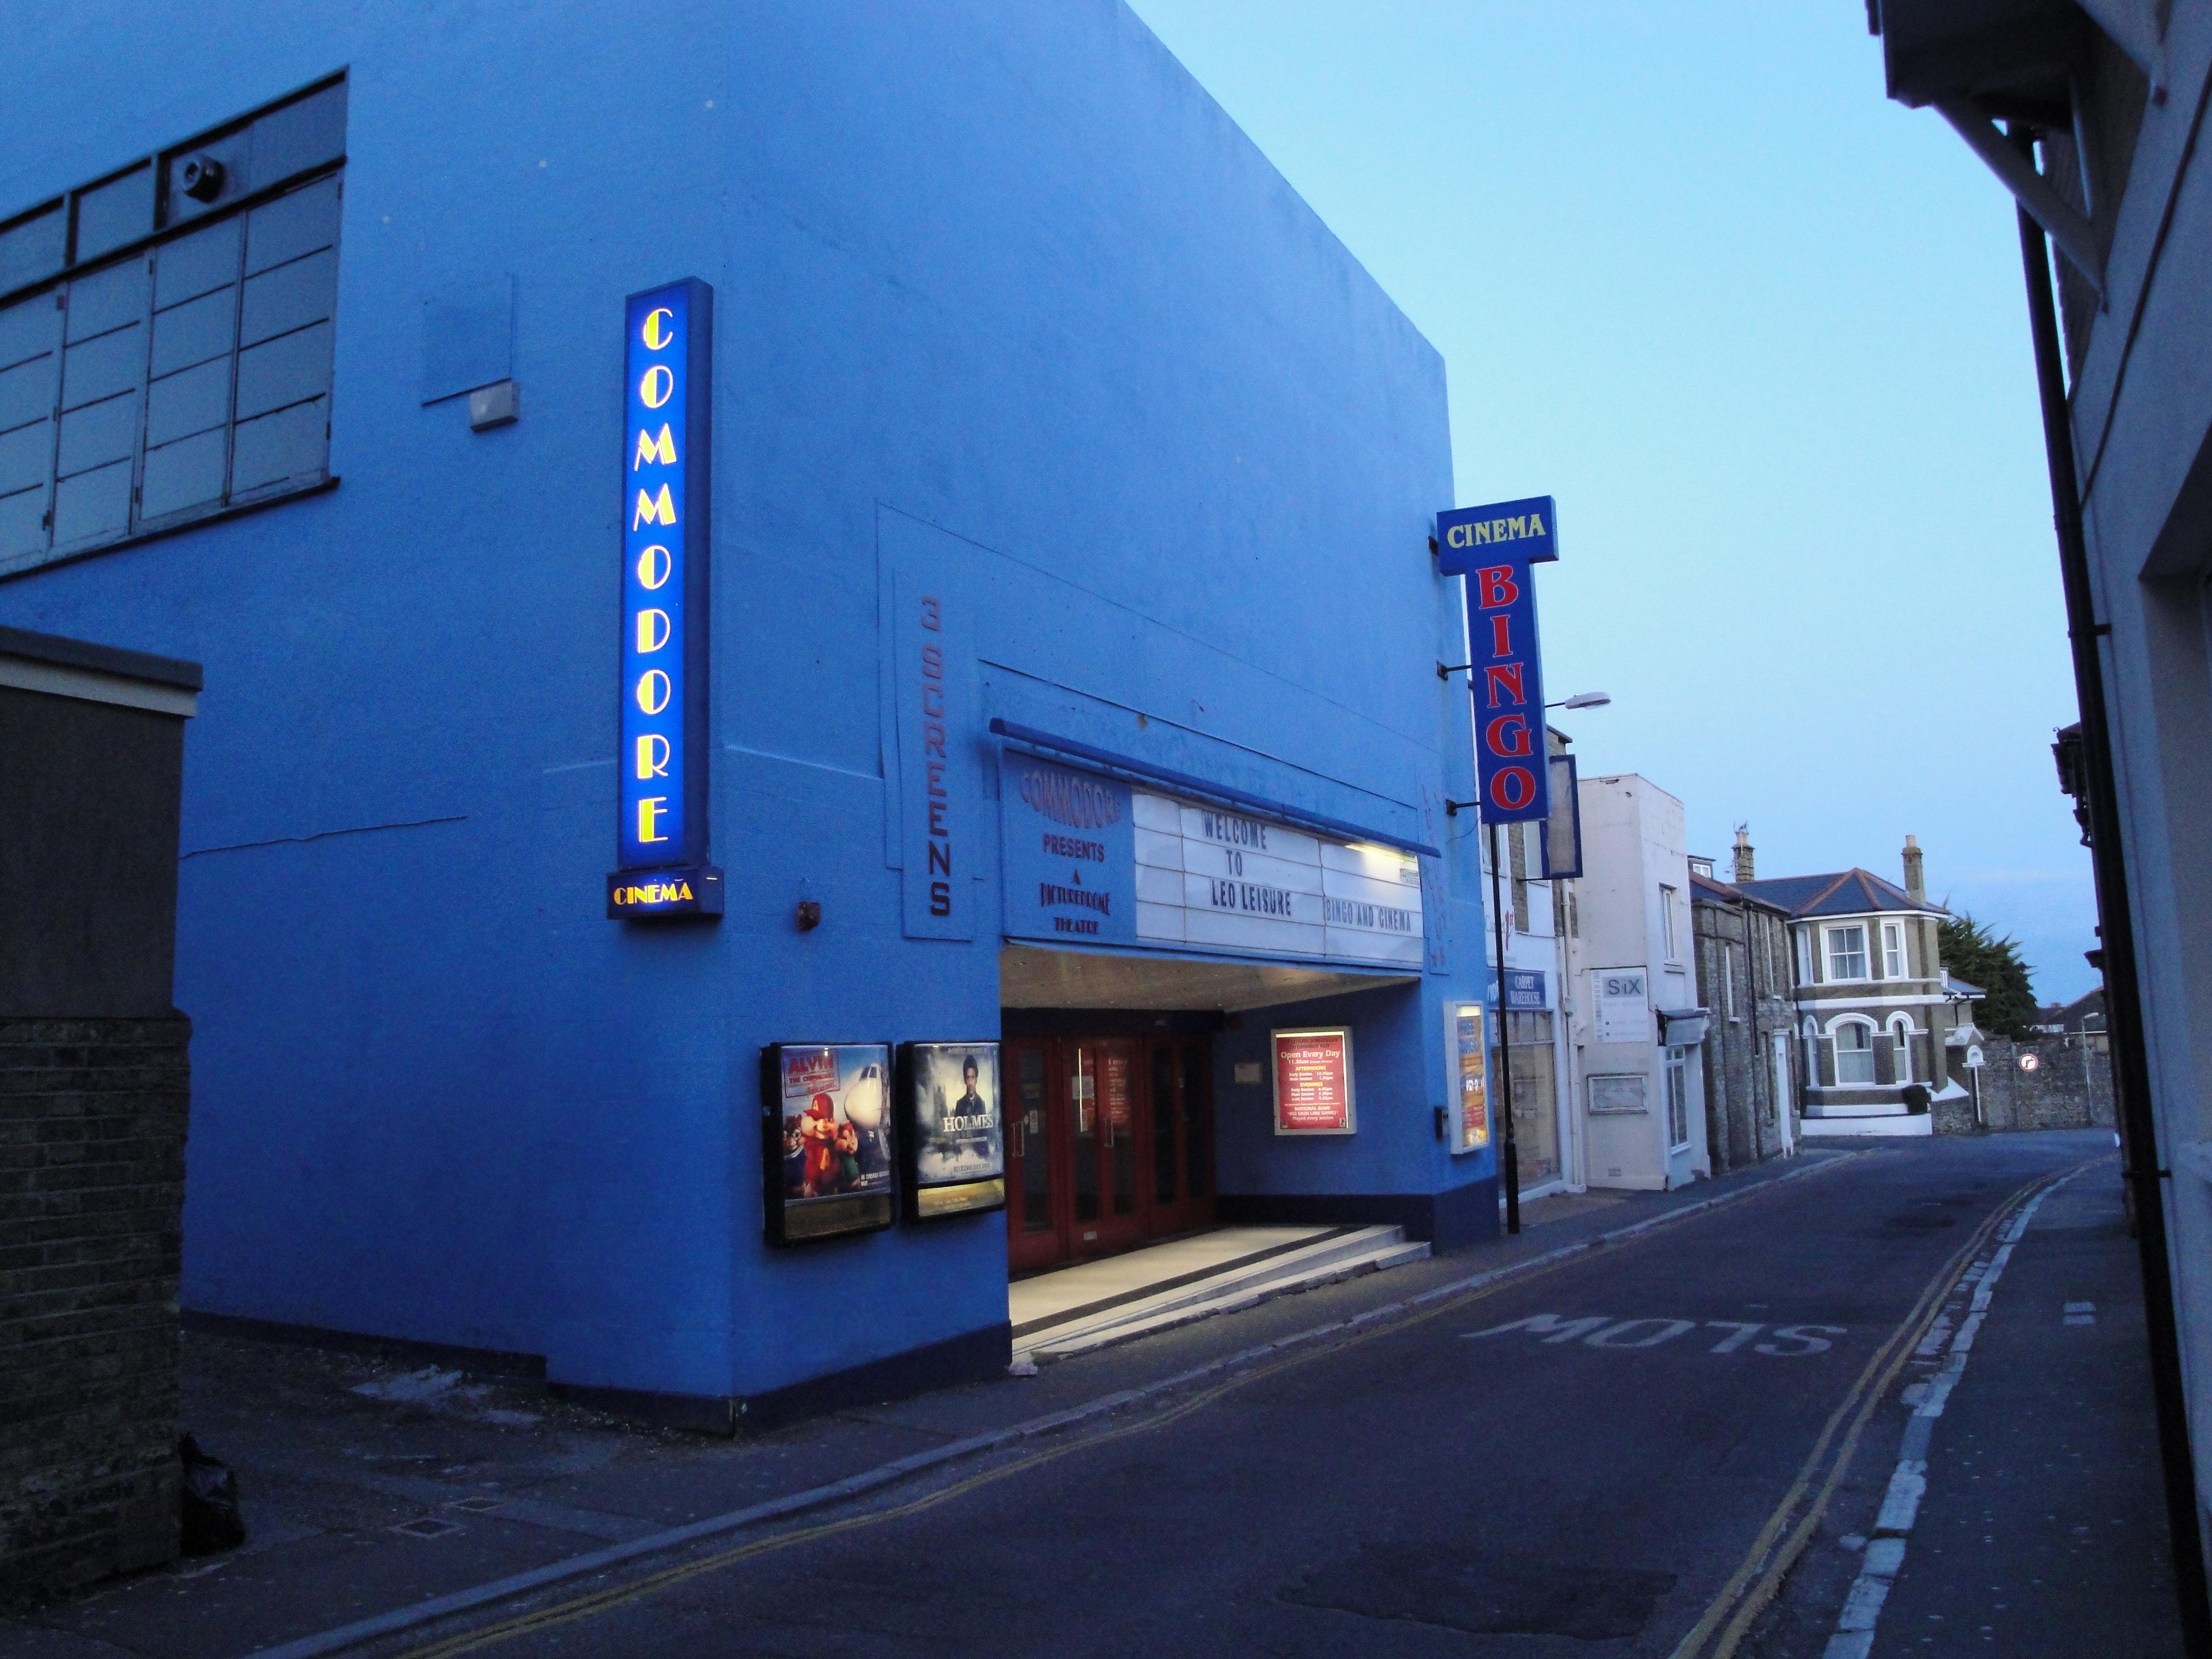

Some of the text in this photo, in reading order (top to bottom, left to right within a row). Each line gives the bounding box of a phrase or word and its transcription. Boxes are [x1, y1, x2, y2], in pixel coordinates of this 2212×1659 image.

[1446, 514, 1546, 549] CINEMA
[633, 307, 677, 842] COMMODORE
[1475, 564, 1536, 810] BINGO
[921, 594, 951, 917] 3 SCREENS
[1202, 809, 1267, 851] WELCOME
[1042, 832, 1105, 863] PRESENTS
[1072, 868, 1081, 885] A
[1226, 849, 1243, 877] TO
[613, 881, 693, 905] CINEMA
[1212, 878, 1291, 916] LEO LEISURE
[1327, 898, 1412, 932] BINGO AND CINEMA
[1515, 975, 1533, 989] CARPET
[1510, 990, 1540, 1005] WAREHOUSE
[788, 1053, 834, 1073] ALVIN
[1281, 1052, 1301, 1060] Open
[942, 1114, 994, 1133] HOLMES
